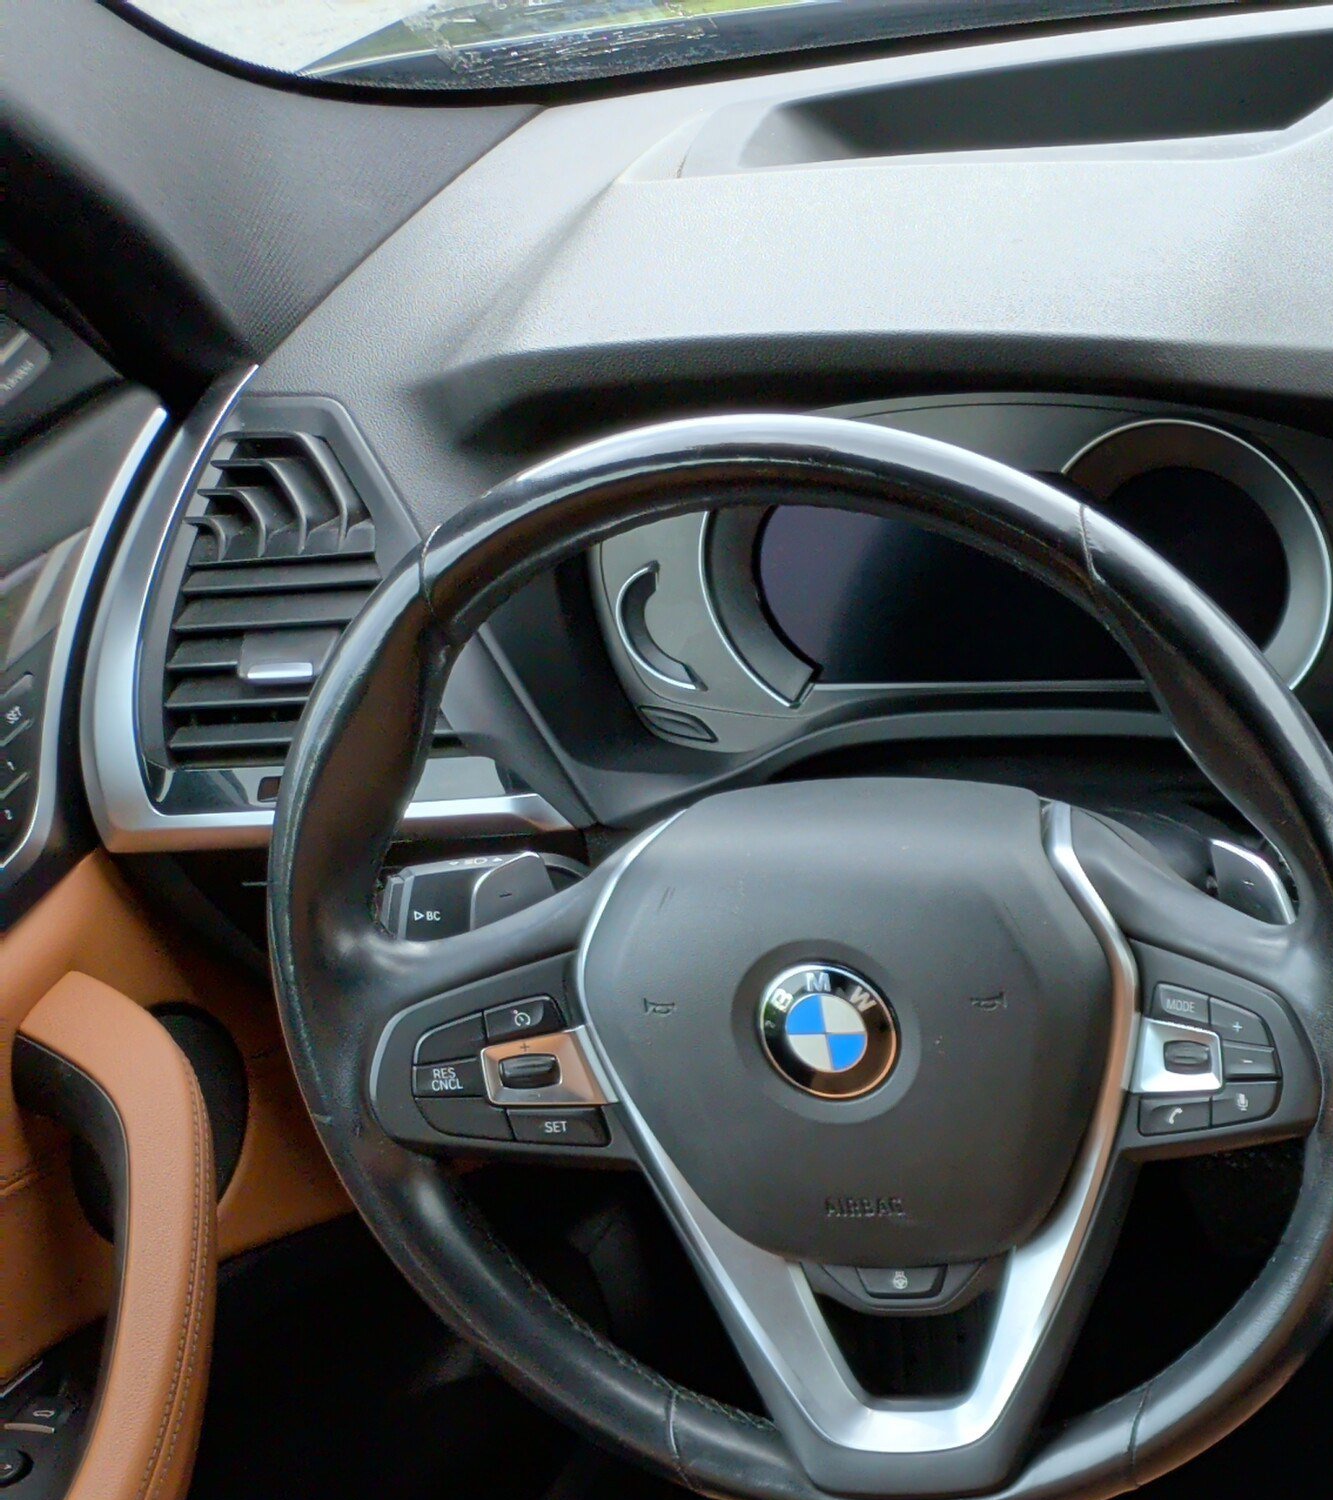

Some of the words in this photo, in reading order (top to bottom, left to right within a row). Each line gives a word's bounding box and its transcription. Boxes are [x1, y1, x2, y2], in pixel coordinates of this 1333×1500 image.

[426, 910, 441, 921] BC
[770, 972, 877, 1013] BMW
[1166, 999, 1196, 1013] MODE
[432, 1067, 457, 1079] RES
[431, 1079, 464, 1092] CNCL
[544, 1120, 568, 1133] SET
[825, 1197, 906, 1218] AIRBAG
